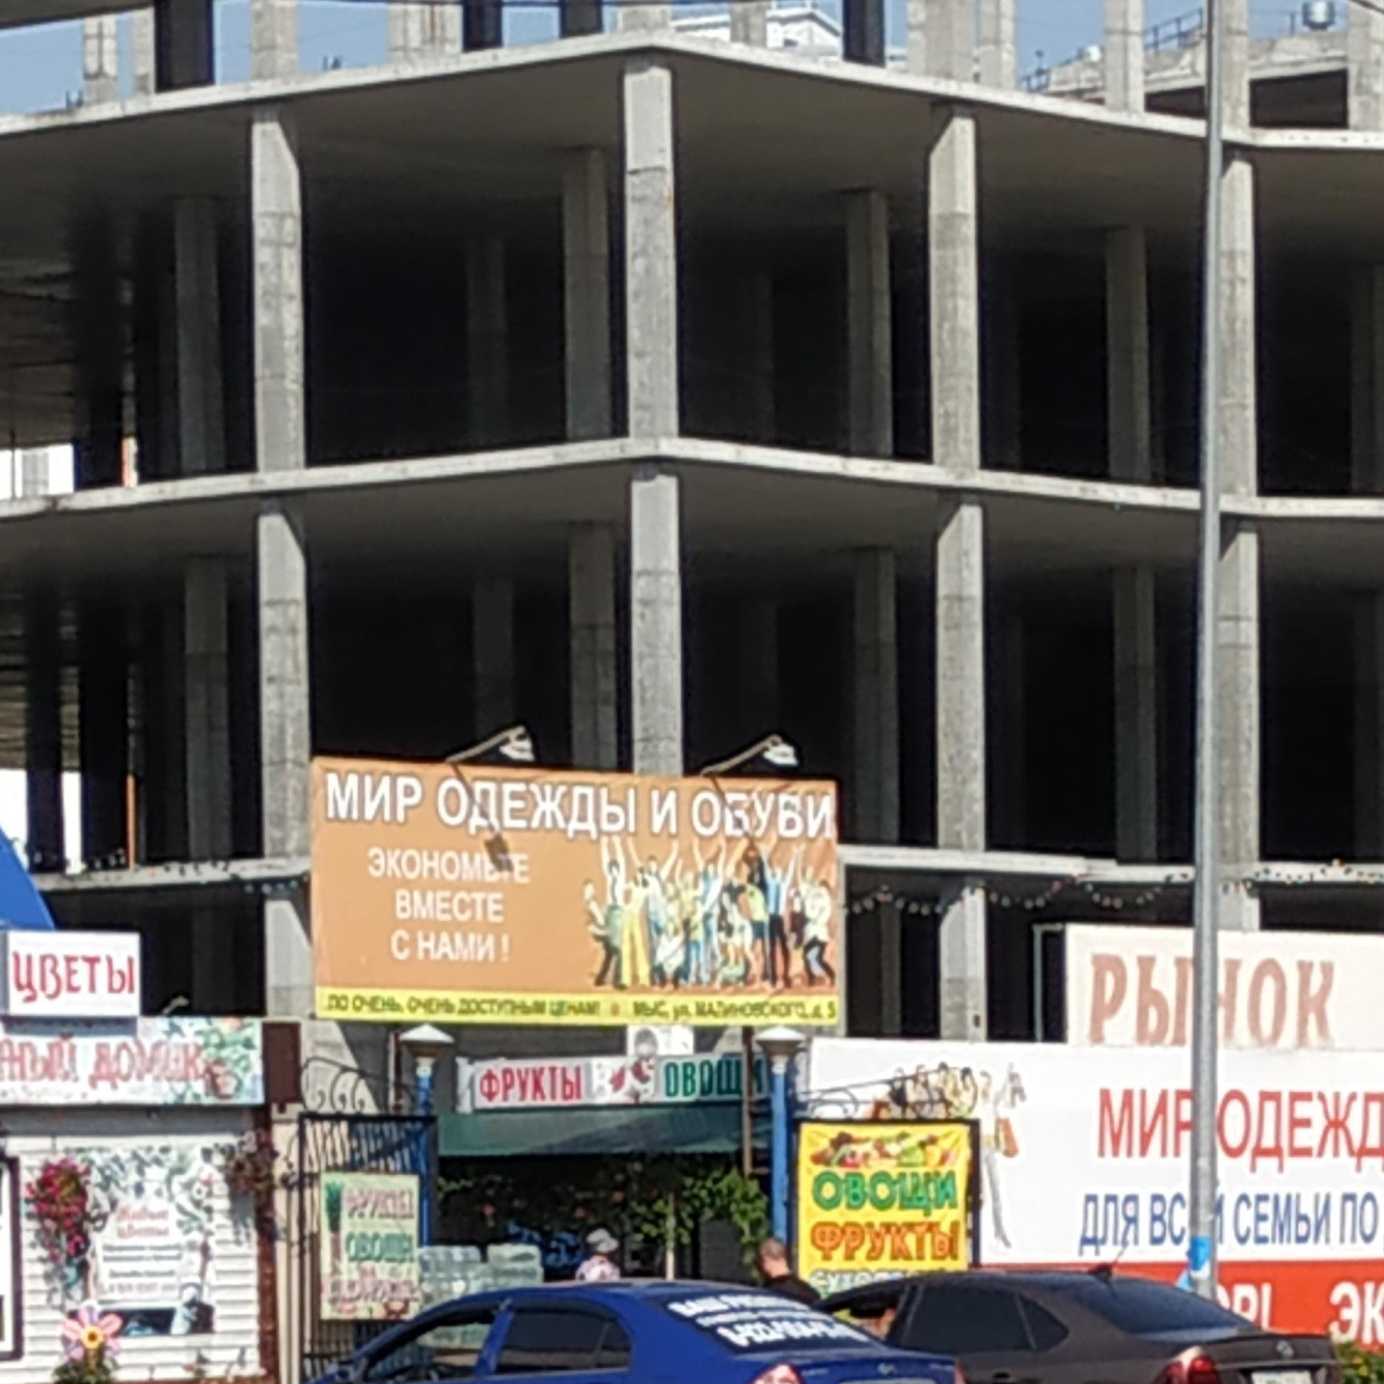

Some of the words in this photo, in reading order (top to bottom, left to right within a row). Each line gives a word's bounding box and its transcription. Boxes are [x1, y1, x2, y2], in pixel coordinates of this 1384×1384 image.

[326, 772, 422, 823] МИР
[437, 778, 637, 837] ОДЕЖДЫ
[651, 787, 678, 834] И
[692, 791, 835, 838] ОБУВИ
[394, 888, 505, 923] ВМЕСТЕ
[389, 928, 411, 961] С
[416, 929, 496, 963] НАМИ
[12, 950, 136, 1003] ЦВЕТЫ
[328, 993, 350, 1012] ПО
[479, 1065, 582, 1103] ФРУКТЫ
[811, 1169, 958, 1217] ОВОЩИ
[810, 1220, 961, 1262] ФРУКТЫ
[1079, 1193, 1140, 1256] ДЛЯ
[1233, 1191, 1332, 1246] СЕМЬИ
[1338, 1191, 1380, 1246] ПО
